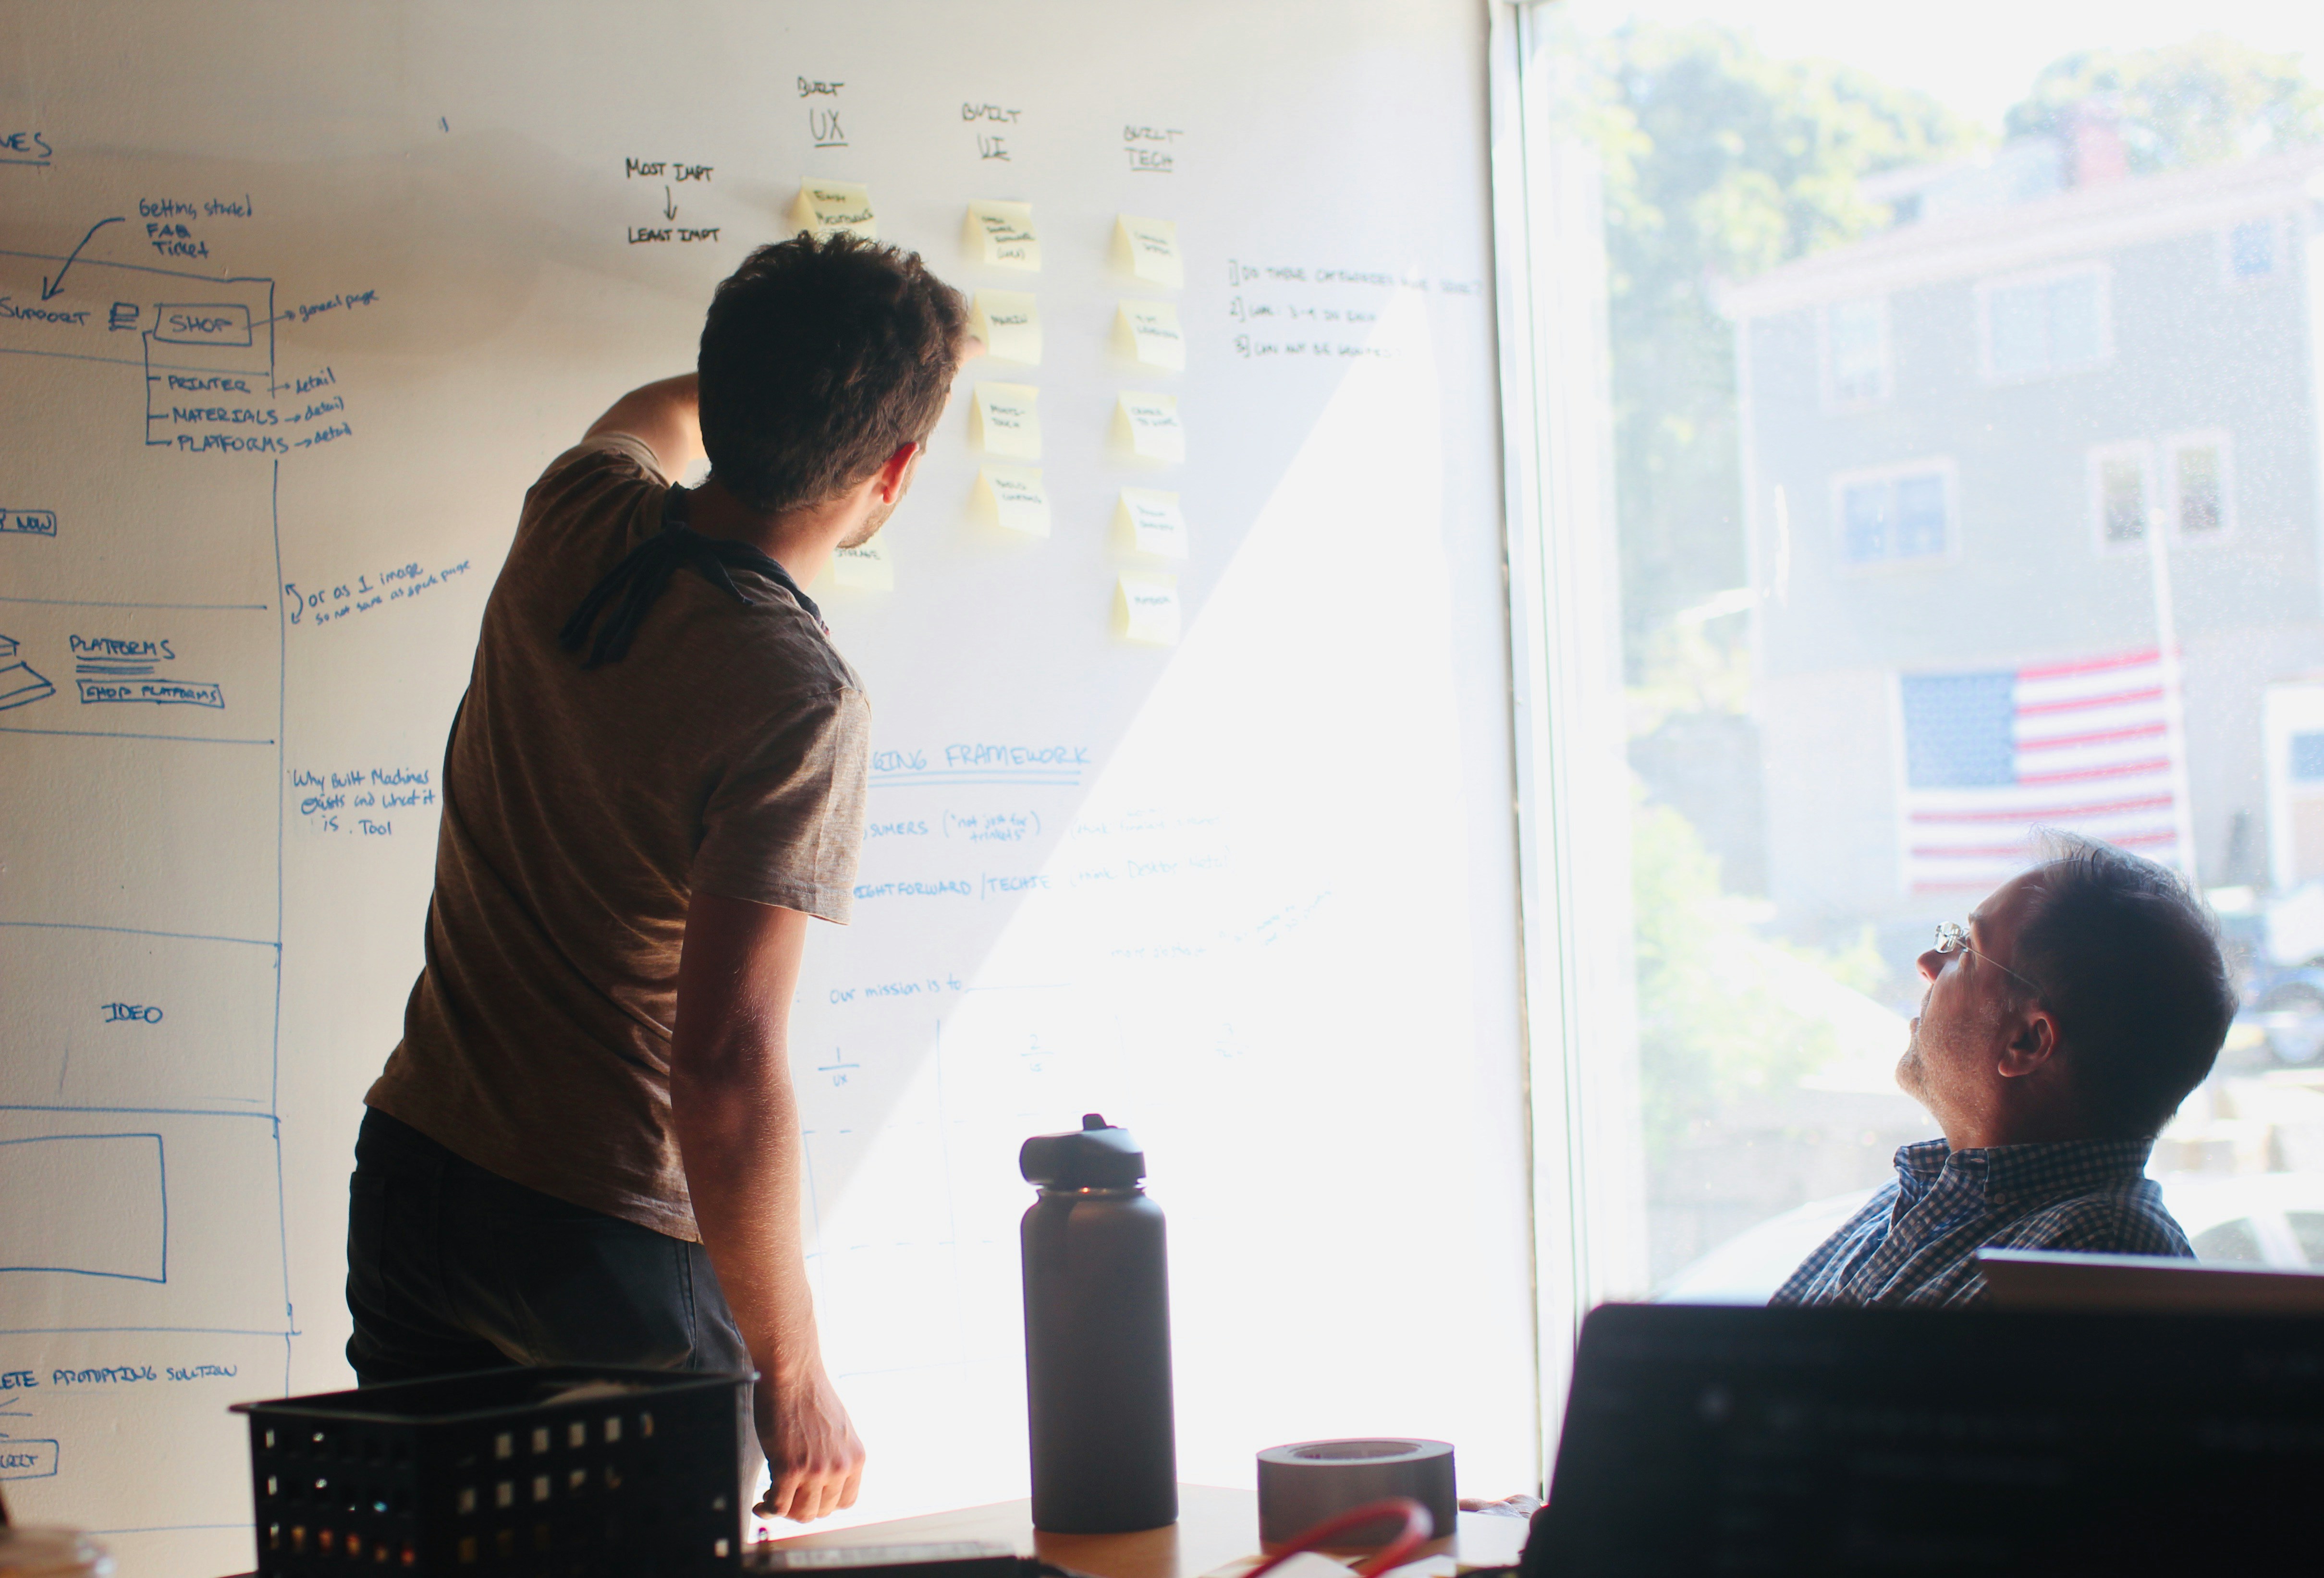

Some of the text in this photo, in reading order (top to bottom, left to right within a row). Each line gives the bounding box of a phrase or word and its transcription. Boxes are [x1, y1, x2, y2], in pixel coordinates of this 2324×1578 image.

[962, 102, 1023, 124] BUILT
[809, 107, 844, 141] UX
[1124, 124, 1185, 145] BUILT
[1123, 147, 1174, 166] TECH
[625, 157, 667, 180] MOST
[628, 226, 673, 244] LEAST
[169, 315, 232, 333] SHOP
[168, 375, 251, 394] PRINTER
[172, 407, 279, 425] MATERIALS
[177, 434, 289, 454] PLATFORMS
[307, 590, 326, 608] or
[70, 634, 176, 660] PLATFORMS
[141, 685, 218, 704] PLATFORMS
[869, 743, 1091, 771] GING FRAMEWORK
[293, 769, 325, 792] Why
[358, 819, 392, 836] Tool
[863, 820, 929, 840] SUMERS
[864, 982, 922, 997] mission
[926, 978, 941, 993] is
[946, 972, 962, 991] to
[101, 1002, 164, 1024] IDEO
[0, 1370, 40, 1390] ETE
